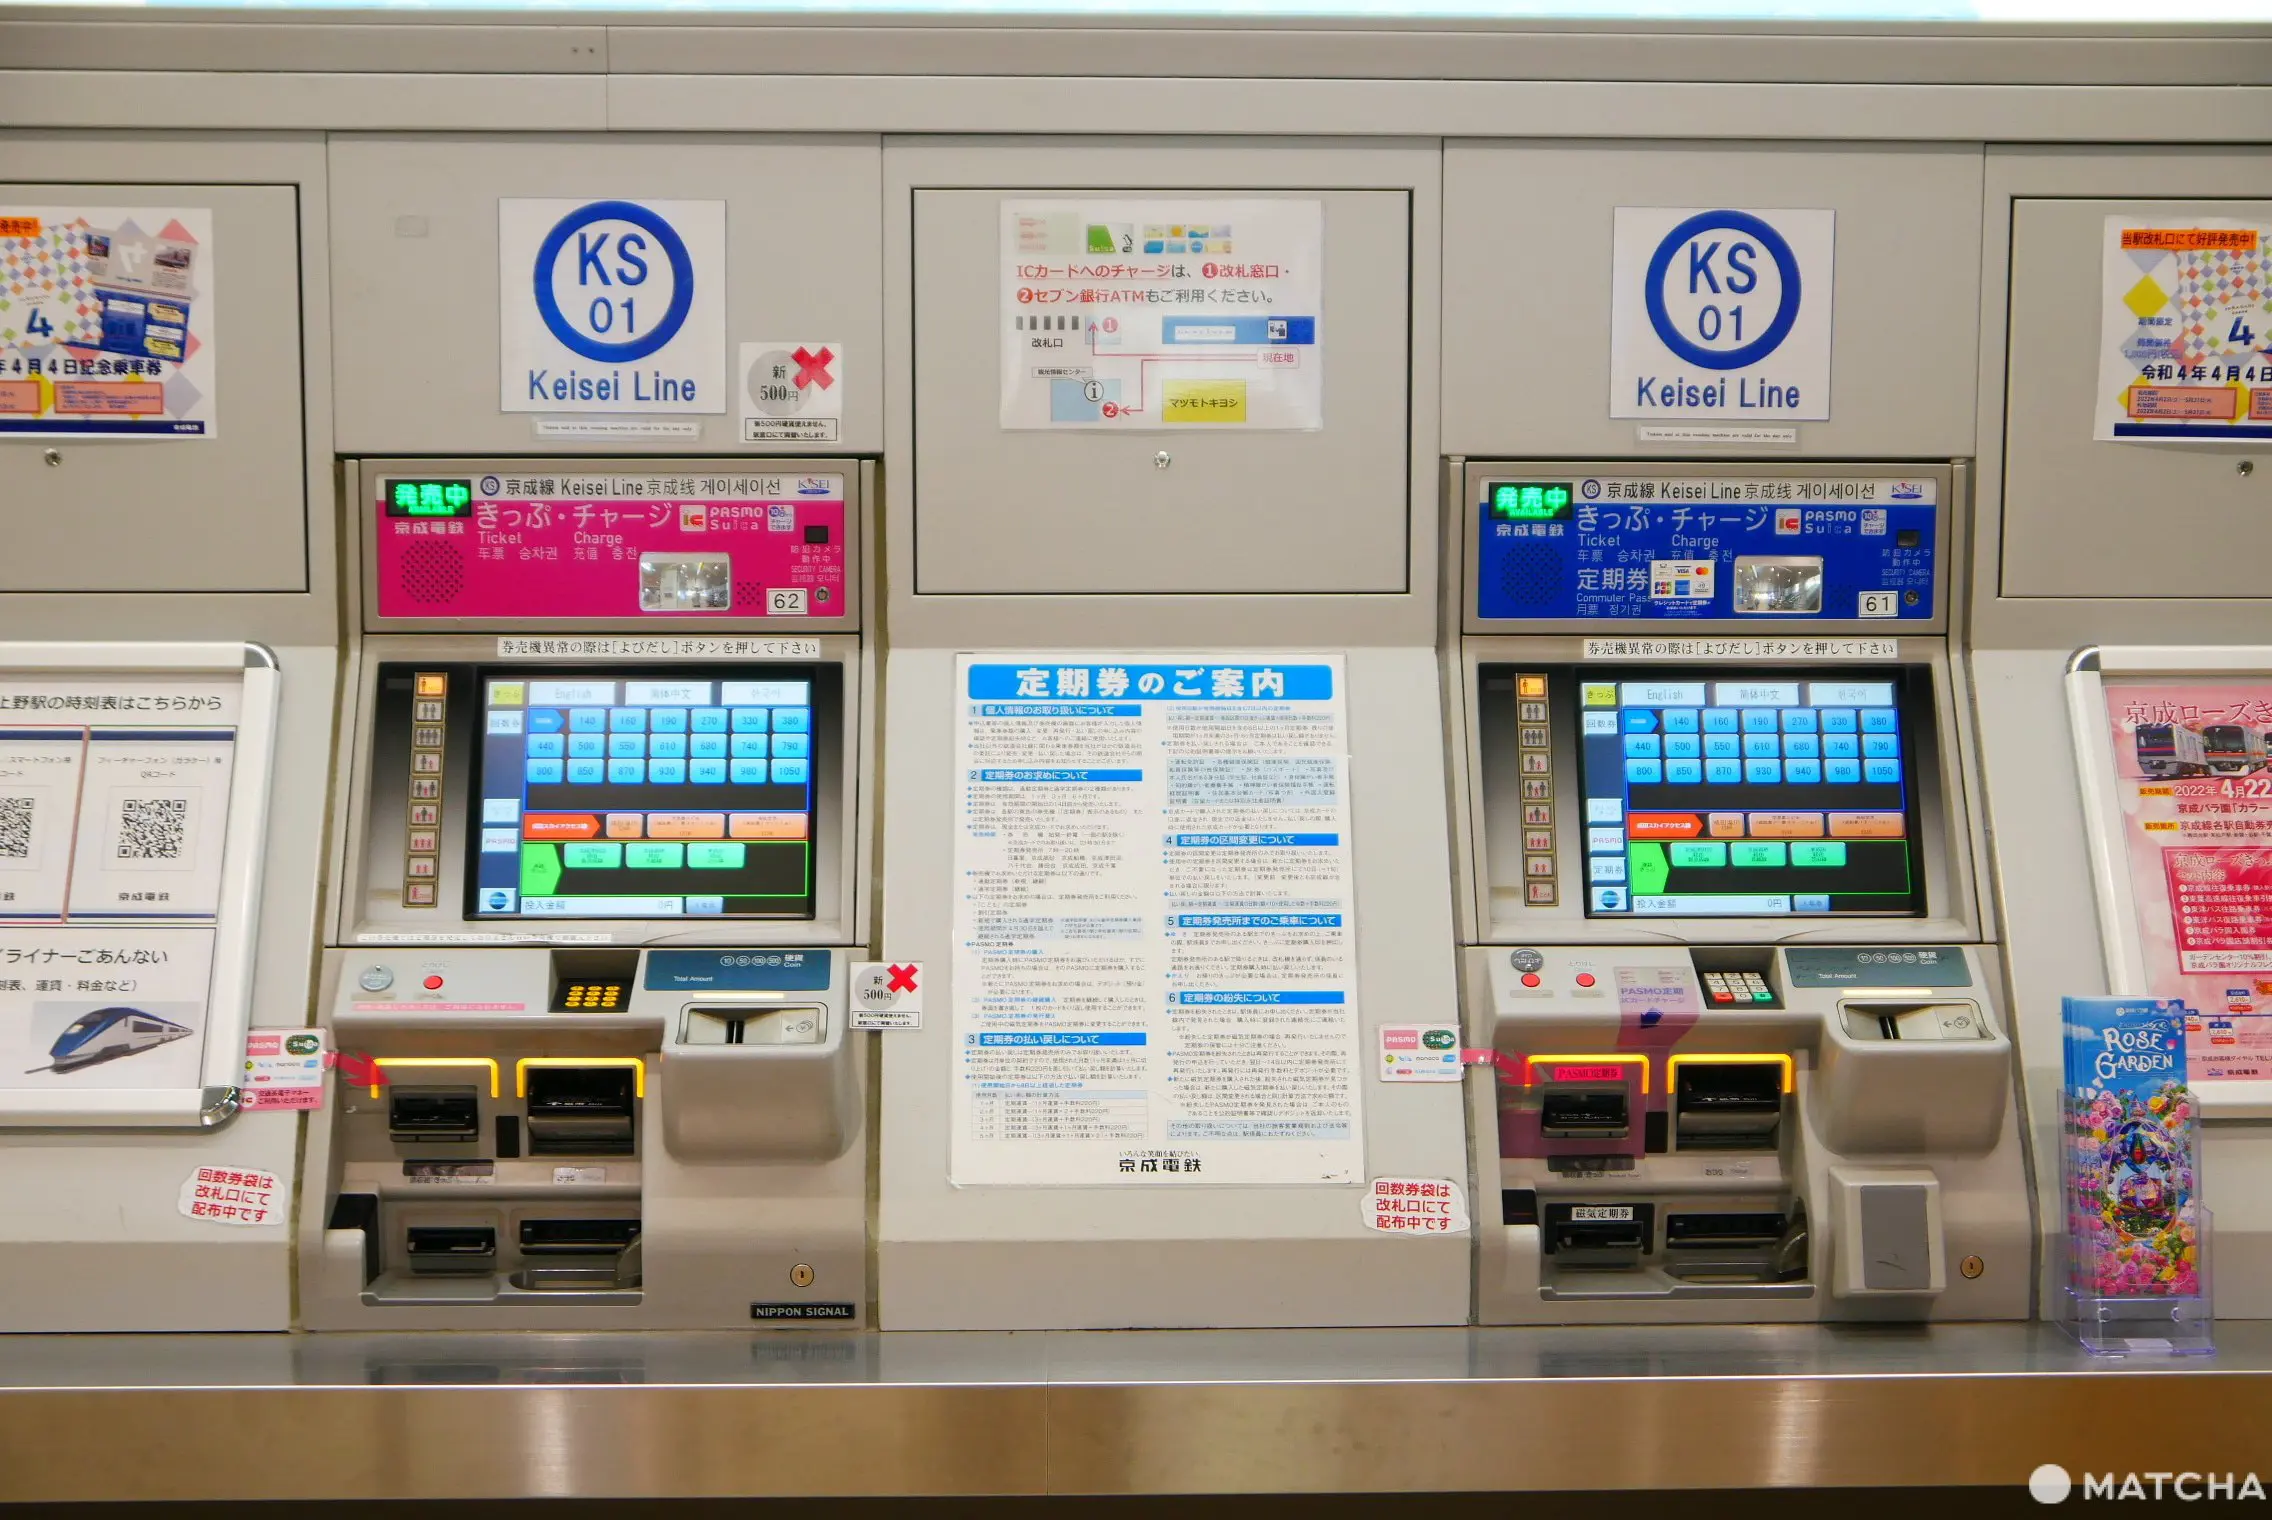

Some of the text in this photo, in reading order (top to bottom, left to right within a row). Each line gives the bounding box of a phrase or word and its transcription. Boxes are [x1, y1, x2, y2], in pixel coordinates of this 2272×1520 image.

[577, 232, 648, 286] KS
[1689, 241, 1758, 294] KS
[589, 297, 635, 334] 01
[1698, 305, 1743, 341] 01
[2228, 315, 2256, 345] 4
[1031, 337, 1063, 348] 改札口
[1262, 352, 1294, 364] 現在地
[772, 365, 786, 380] 新
[528, 369, 696, 401] Keisei Line
[759, 383, 799, 402] 500円
[1638, 377, 1800, 408] Keisei Line
[1169, 398, 1238, 408] マツモトキヨシ
[506, 479, 781, 496] 京成線 Keisei Line 京成线 게이세이선
[1608, 482, 1875, 500] 京成線 Keisei Line 京成线 게이세이선
[1496, 487, 1567, 509] 発売中
[477, 501, 672, 529] きっぷ・チャージ
[709, 506, 763, 518] PASMO
[1577, 505, 1768, 532] きっぷ・チャージ
[1805, 511, 1857, 521] PASMO
[395, 521, 464, 534] 京成電鉄
[710, 519, 759, 530] Suica
[1497, 524, 1564, 536] 京成電鉄
[1804, 523, 1852, 534] Suica
[478, 531, 623, 547] Ticket Charge
[1578, 534, 1719, 549] Ticket Charge
[1577, 567, 1649, 591] 定期券
[773, 593, 799, 608] 62
[1576, 593, 1625, 602] Commuter
[1865, 596, 1890, 611] 61
[1016, 667, 1284, 698] 定期券のご案内
[555, 688, 592, 701] English
[1586, 690, 1614, 699] きっぷ
[1646, 689, 1683, 701] English
[972, 706, 977, 714] 1
[1586, 719, 1616, 729] 回数券
[1673, 717, 1689, 727] 140
[1713, 717, 1729, 727] 160
[1753, 717, 1769, 727] 190
[1792, 717, 1808, 727] 270
[1871, 717, 1887, 727] 380
[1635, 741, 1651, 751] 440
[1675, 741, 1691, 751] 500
[1714, 741, 1730, 751] 550
[1833, 741, 1849, 751] 740
[1873, 741, 1889, 751] 790
[970, 770, 1088, 780] 2 定期券のお求めについて
[1716, 767, 1732, 776] 870
[1872, 767, 1893, 776] 1050
[2175, 785, 2217, 796] 2022年
[1165, 835, 1295, 845] 4 定期券の区間変更について
[1594, 865, 1623, 874] 定期券
[525, 900, 566, 910] 投入金額
[1636, 899, 1782, 909] 投入金額 0円
[1167, 916, 1175, 926] 5
[0, 948, 168, 964] ライナーごあんない
[873, 976, 883, 985] 新
[863, 988, 892, 1001] 500円
[1168, 993, 1280, 1003] 6 定期券の紛失について
[967, 1034, 1100, 1045] 3 定期券の払い戻しについて
[2102, 1027, 2165, 1053] ROSE
[2095, 1052, 2173, 1079] GARDEN
[1558, 1068, 1618, 1079] PASMO定期券
[1119, 1158, 1202, 1173] 京成電鉄
[197, 1167, 274, 1190] 回数券袋は
[194, 1184, 272, 1206] 改札口にて
[1375, 1182, 1450, 1197] 回数券袋は
[191, 1201, 268, 1222] 配布中です
[1375, 1199, 1450, 1214] 改札口にて
[1575, 1207, 1630, 1219] 磁気定期券
[1375, 1215, 1451, 1231] 配布中です
[755, 1305, 849, 1317] NIPPON SIGNAL
